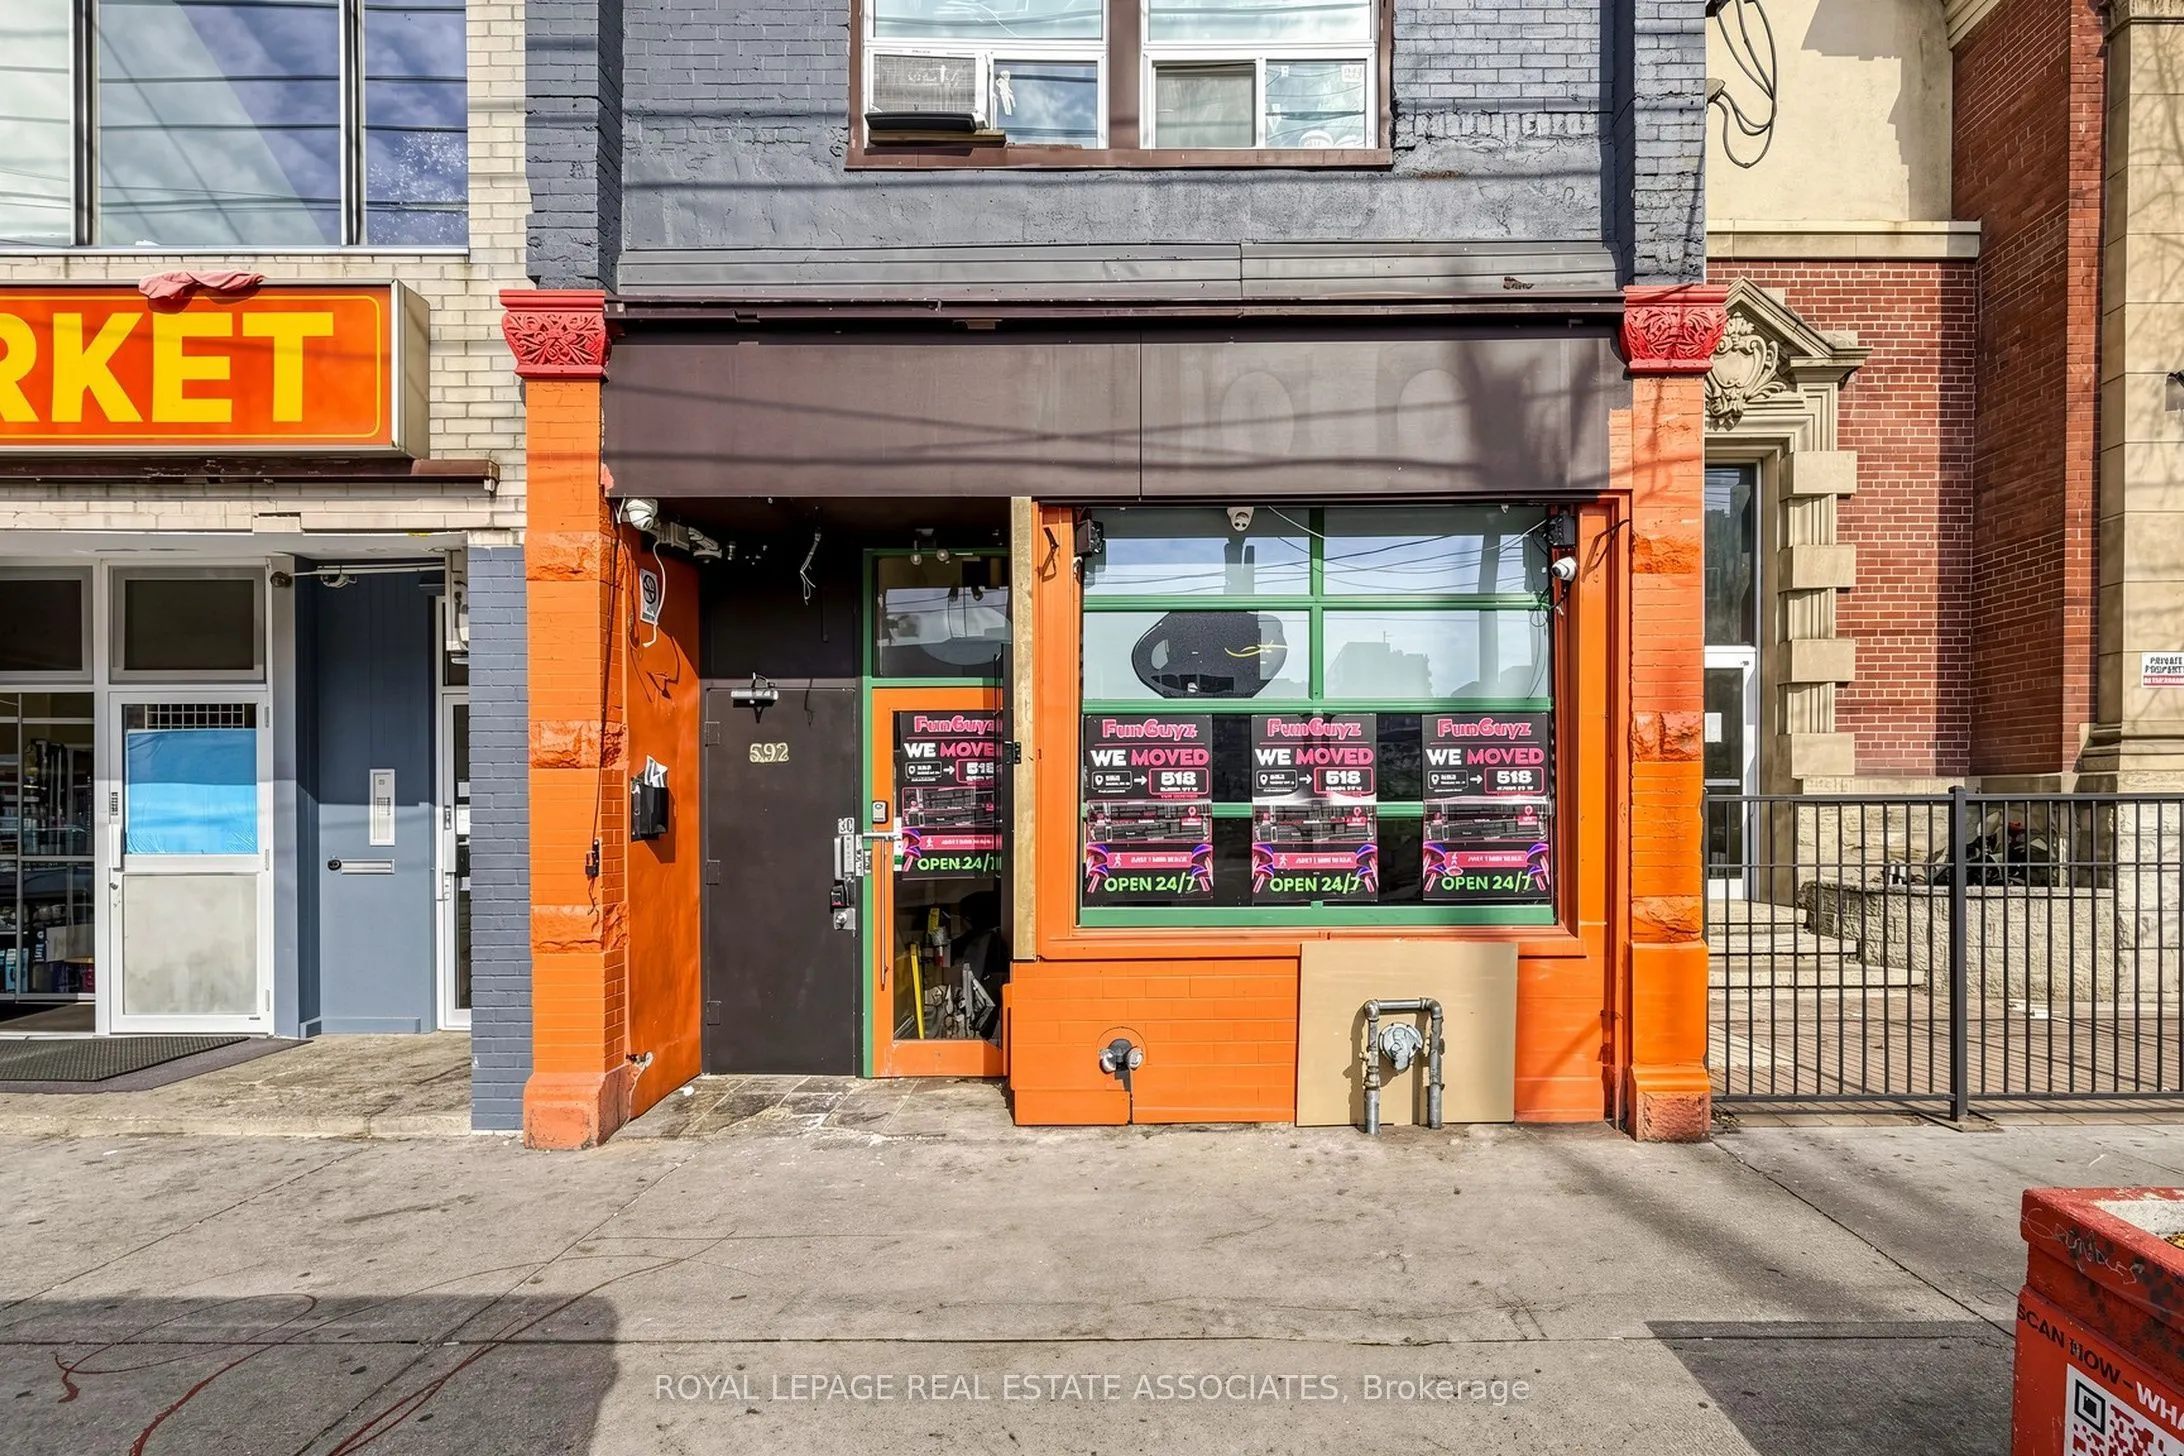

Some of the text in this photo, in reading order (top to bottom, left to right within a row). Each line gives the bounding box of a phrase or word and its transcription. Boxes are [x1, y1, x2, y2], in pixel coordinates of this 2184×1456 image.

[1102, 719, 1198, 741] FunGuyz
[1267, 717, 1362, 740] FunGuyz
[1437, 717, 1532, 740] FunGuyz
[750, 743, 789, 763] 592
[904, 742, 995, 758] WE MOVE
[1090, 748, 1209, 767] WE MOVED
[1255, 747, 1374, 766] WE MOVED
[1426, 747, 1545, 766] WE MOVED
[1161, 771, 1197, 786] 518
[1325, 770, 1361, 785] 518
[1496, 770, 1532, 785] 518
[917, 857, 960, 871] OPEN
[1104, 872, 1195, 894] OPEN 24/7
[1269, 872, 1361, 894] OPEN 24/7
[1441, 871, 1531, 892] OPEN 24/7
[2017, 1303, 2065, 1349] SCAN
